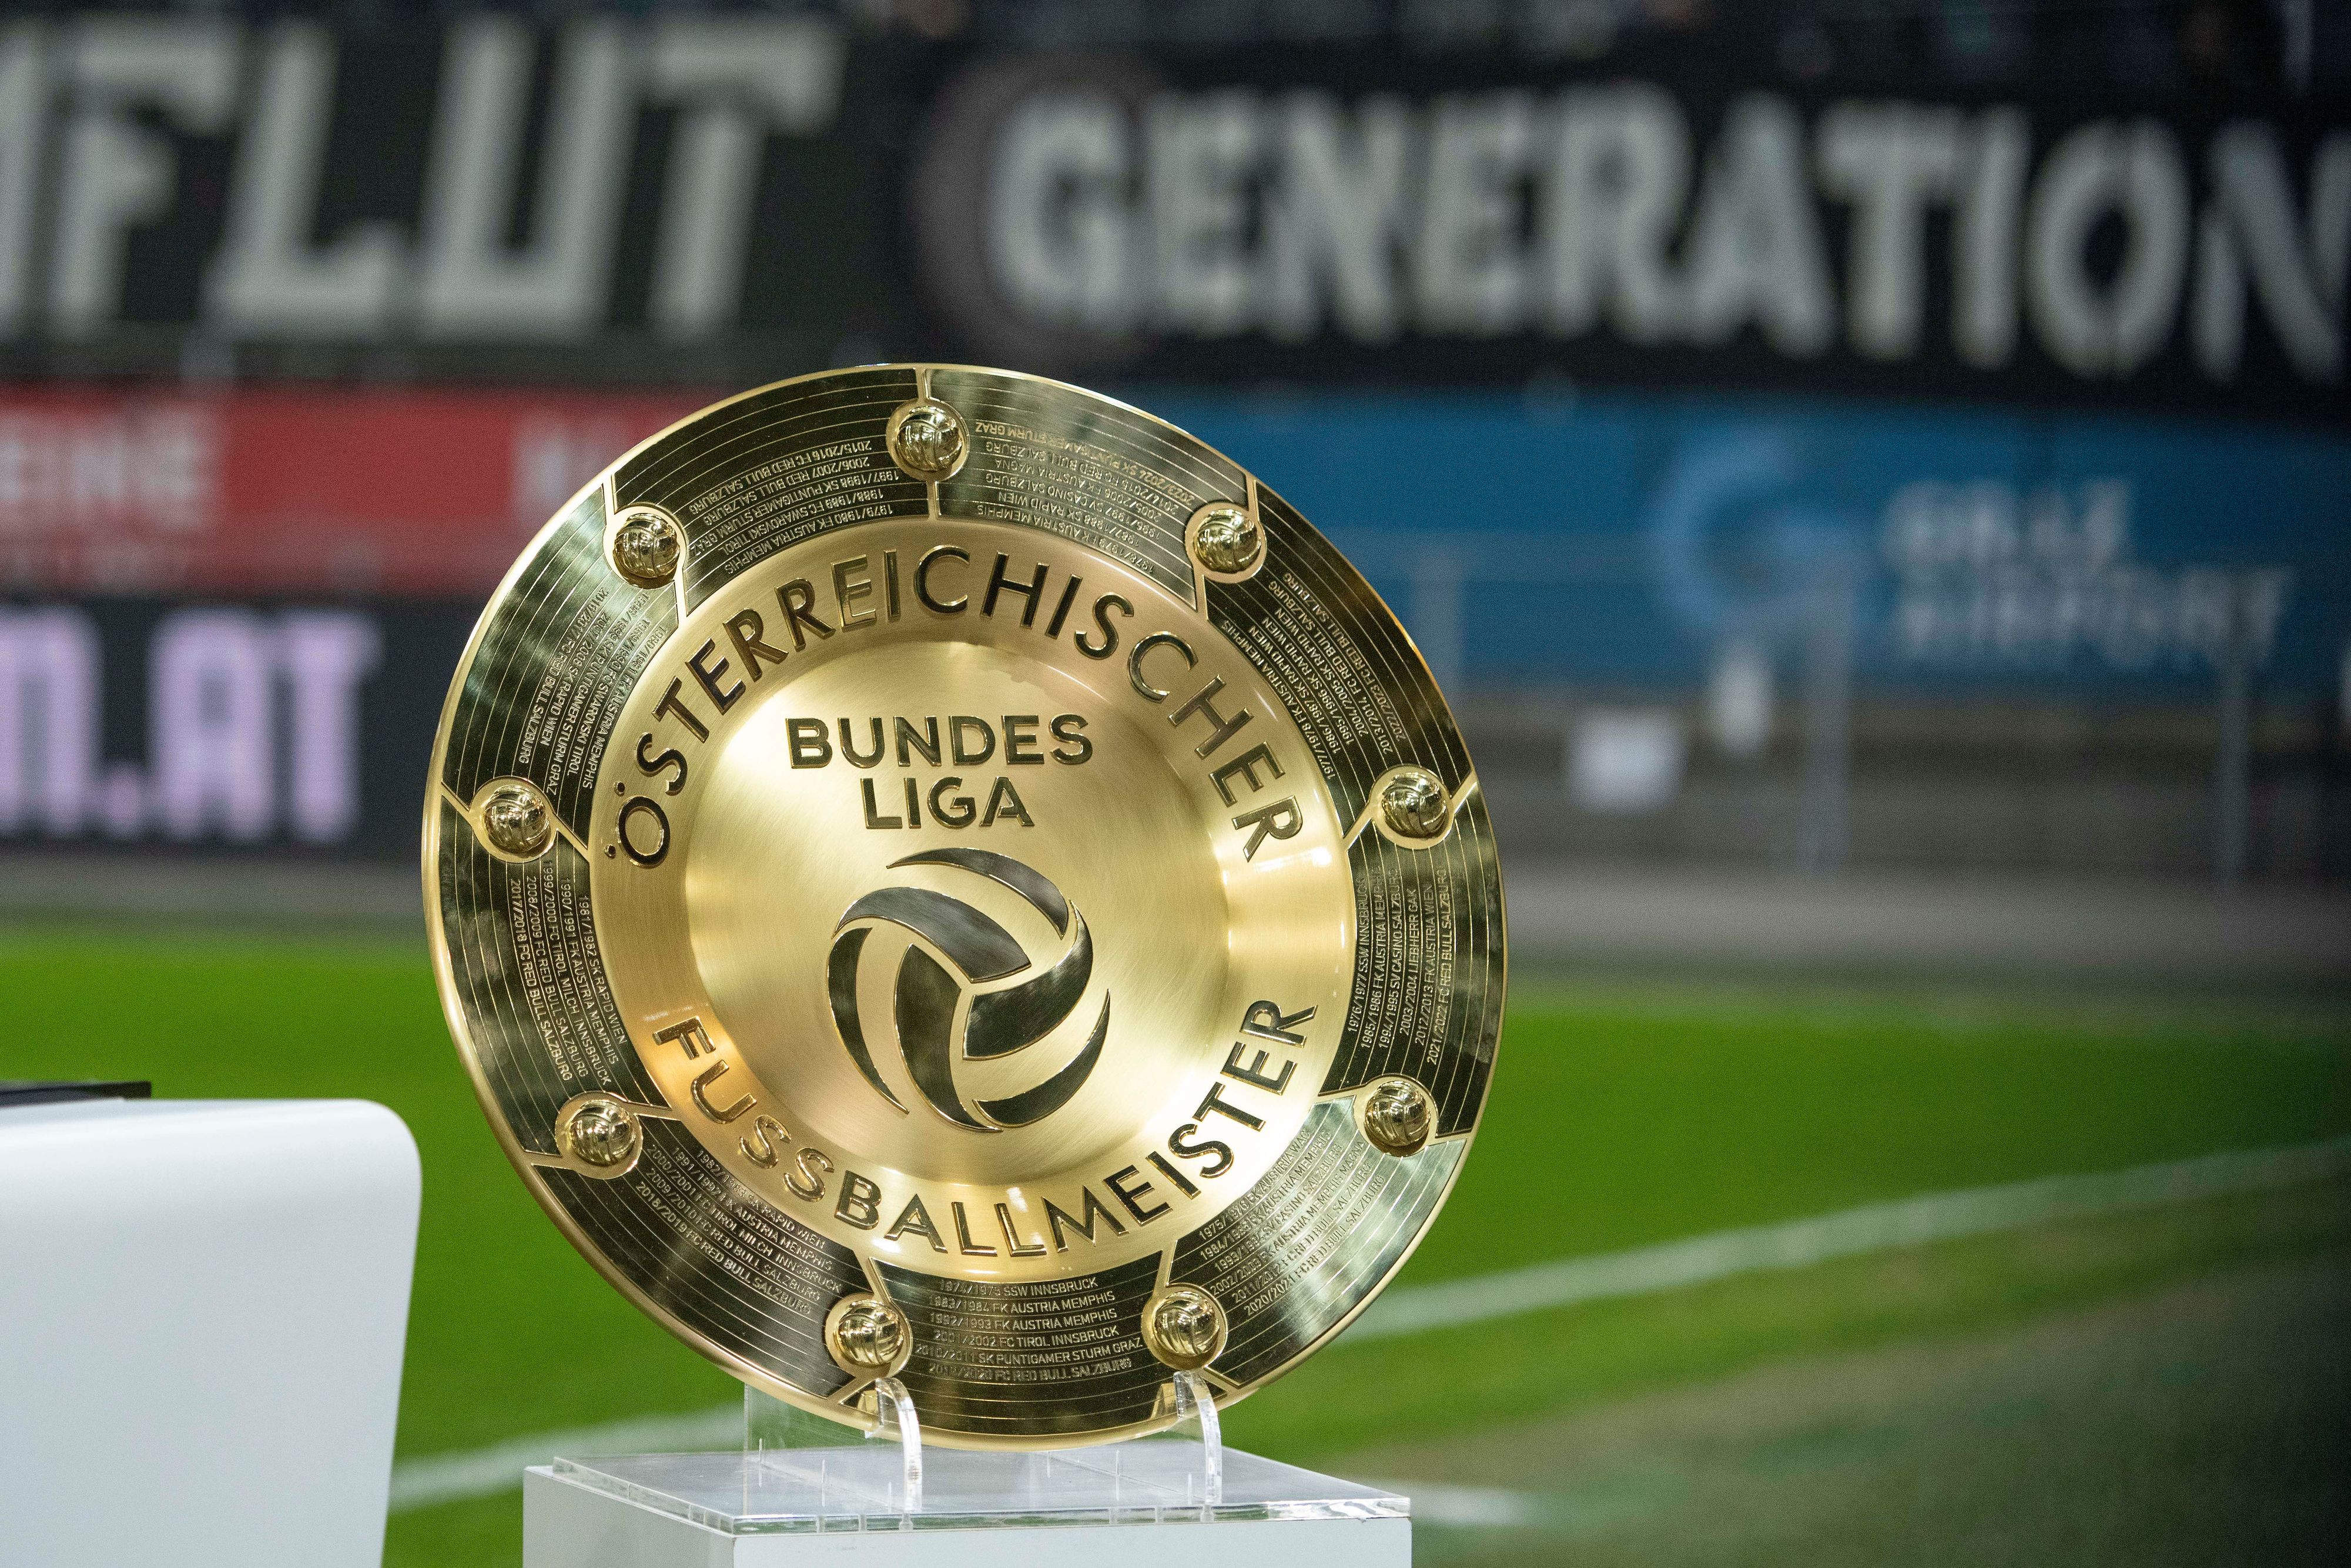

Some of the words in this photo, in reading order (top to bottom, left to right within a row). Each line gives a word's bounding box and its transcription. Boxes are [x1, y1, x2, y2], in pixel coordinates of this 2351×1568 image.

[0, 11, 843, 338] FLUT
[785, 469, 809, 486] RED
[809, 455, 869, 478] 2006/2007
[839, 469, 899, 488] 1997/1998
[755, 477, 786, 498] BULL
[822, 479, 839, 492] SK
[824, 488, 883, 509] 1988/1989
[985, 472, 1046, 494] SALZBURG
[999, 491, 1028, 506] WIEN
[1047, 484, 1088, 507] CASINO
[702, 490, 758, 527] SALZBURG
[751, 483, 823, 518] PUNTIGAMER
[808, 501, 824, 514] FC
[833, 504, 893, 524] 1979/1980
[977, 504, 1030, 523] MEMPHIS
[1030, 497, 1064, 516] RAPID
[1066, 507, 1082, 522] SK
[1089, 498, 1104, 513] SV
[715, 511, 754, 538] STURM
[747, 505, 809, 540] SWAROVSKI
[769, 520, 818, 548] AUSTRIA
[816, 515, 833, 530] FK
[1032, 514, 1080, 538] AUSTRIA
[1081, 530, 1097, 545] FK
[1083, 513, 1141, 547] 1987/1988
[689, 531, 718, 556] GRAZ
[718, 532, 750, 557] TIROL
[722, 540, 772, 574] MEMPHIS
[1266, 579, 1317, 631] SALZBURG
[1272, 607, 1301, 636] WIEN
[560, 636, 576, 655] FC
[1220, 619, 1265, 666] MEMPHIS
[1246, 624, 1275, 655] WIEN
[1295, 632, 1325, 666] RAPID
[1310, 628, 1337, 657] BULL
[548, 651, 568, 677] RED
[564, 665, 579, 683] SK
[602, 667, 617, 685] FC
[1270, 650, 1300, 684] RAPID
[1319, 663, 1336, 681] SK
[1330, 654, 1353, 680] RED
[535, 674, 556, 706] BULL
[549, 680, 571, 716] RAPID
[1259, 662, 1297, 708] AUSTRIA
[1293, 681, 1310, 699] SK
[1345, 676, 1362, 695] FC
[575, 681, 609, 744] SWAROVSKI
[604, 544, 1304, 862] ÖSTERREICHISCHER
[1290, 705, 1307, 723] FK
[1329, 679, 1369, 736] 2004/2005
[517, 703, 544, 764] SALZBURG
[539, 715, 557, 746] WIEN
[1303, 696, 1343, 754] 1986/1987
[1356, 696, 1394, 754] 2013/2014
[785, 714, 1094, 769] BUNDES
[1301, 722, 1337, 779] 1977/1978
[566, 743, 584, 778] TIROL
[859, 776, 1035, 829] LIGA
[526, 876, 542, 937] 2008/2009
[542, 860, 557, 923] 1999/2000
[560, 877, 577, 937] 1990/1991
[1386, 867, 1402, 929] SALZBURG
[1405, 887, 1418, 912] GAK
[1421, 884, 1435, 914] WIEN
[1433, 864, 1452, 929] SALZBURG
[548, 925, 560, 940] FC
[577, 896, 598, 957] 1981/1982
[1424, 917, 1436, 966] AUSTRIA
[533, 940, 545, 956] FC
[567, 942, 580, 957] FK
[1391, 931, 1402, 972] CASINO
[1408, 914, 1419, 972] LIEBHERR
[1441, 930, 1452, 960] BULL
[536, 958, 552, 983] RED
[550, 942, 568, 976] TIROL
[587, 958, 601, 974] SK
[1424, 966, 1435, 983] FK
[1439, 962, 1452, 986] RED
[559, 978, 580, 1014] MILCH
[571, 959, 596, 1009] AUSTRIA
[592, 977, 615, 1013] RAPID
[1389, 973, 1401, 989] SV
[1438, 986, 1451, 1003] FC
[544, 984, 563, 1016] BULL
[1399, 974, 1418, 1036] 2003/2004
[1414, 985, 1434, 1046] 2012/2013
[605, 1013, 628, 1044] WIEN
[1378, 989, 1399, 1050] 1994/1995
[1426, 1004, 1449, 1065] 2021/2022
[554, 1016, 590, 1077] SALZBURG
[572, 1018, 613, 1085] INNSBRUCK
[586, 1009, 620, 1064] MEMPHIS
[652, 1000, 1318, 1258] FUSSBALLMEISTER
[1245, 1187, 1263, 1204] FK
[1257, 1151, 1295, 1192] AUSTRIA
[1290, 1130, 1311, 1155] WAC
[1258, 1246, 1276, 1262] FK
[1271, 1214, 1311, 1252] AUSTRIA
[1305, 1173, 1344, 1218] MEMPHIS
[1338, 1139, 1366, 1176] MAGNA
[1261, 1221, 1278, 1237] SV
[1273, 1191, 1308, 1226] CASINO
[1302, 1143, 1344, 1195] SALZBURG
[745, 1193, 763, 1210] SK
[760, 1204, 796, 1233] RAPID
[795, 1226, 826, 1249] WIEN
[1294, 1262, 1311, 1279] FC
[1306, 1245, 1329, 1268] RED
[1324, 1221, 1351, 1250] BULL
[1344, 1173, 1386, 1226] SALZBURG
[685, 1228, 703, 1246] FC
[699, 1240, 725, 1264] RED
[722, 1257, 753, 1285] BULL
[751, 1275, 812, 1317] SALZBURG
[709, 1227, 735, 1250] RED
[732, 1244, 763, 1270] BULL
[761, 1263, 821, 1303] SALZBURG
[929, 1294, 989, 1312] 1983/1984
[993, 1302, 1008, 1313] FK
[1010, 1299, 1060, 1313] AUSTRIA
[1061, 1289, 1116, 1309] MEMPHIS
[930, 1311, 991, 1329] 1992/1993
[994, 1319, 1010, 1330] FK
[1012, 1317, 1062, 1330] AUSTRIA
[1063, 1306, 1117, 1327] MEMPHIS
[915, 1343, 974, 1362] 2010/2011
[978, 1352, 994, 1364] SK
[996, 1351, 1070, 1365] PUNTIGAMER
[1071, 1345, 1111, 1361] STURM
[1111, 1336, 1143, 1353] GRAZ
[934, 1329, 996, 1347] 2001/2002
[1000, 1336, 1014, 1347] FC
[1016, 1335, 1050, 1347] TIROL
[1051, 1324, 1120, 1346] INNSBRUCK
